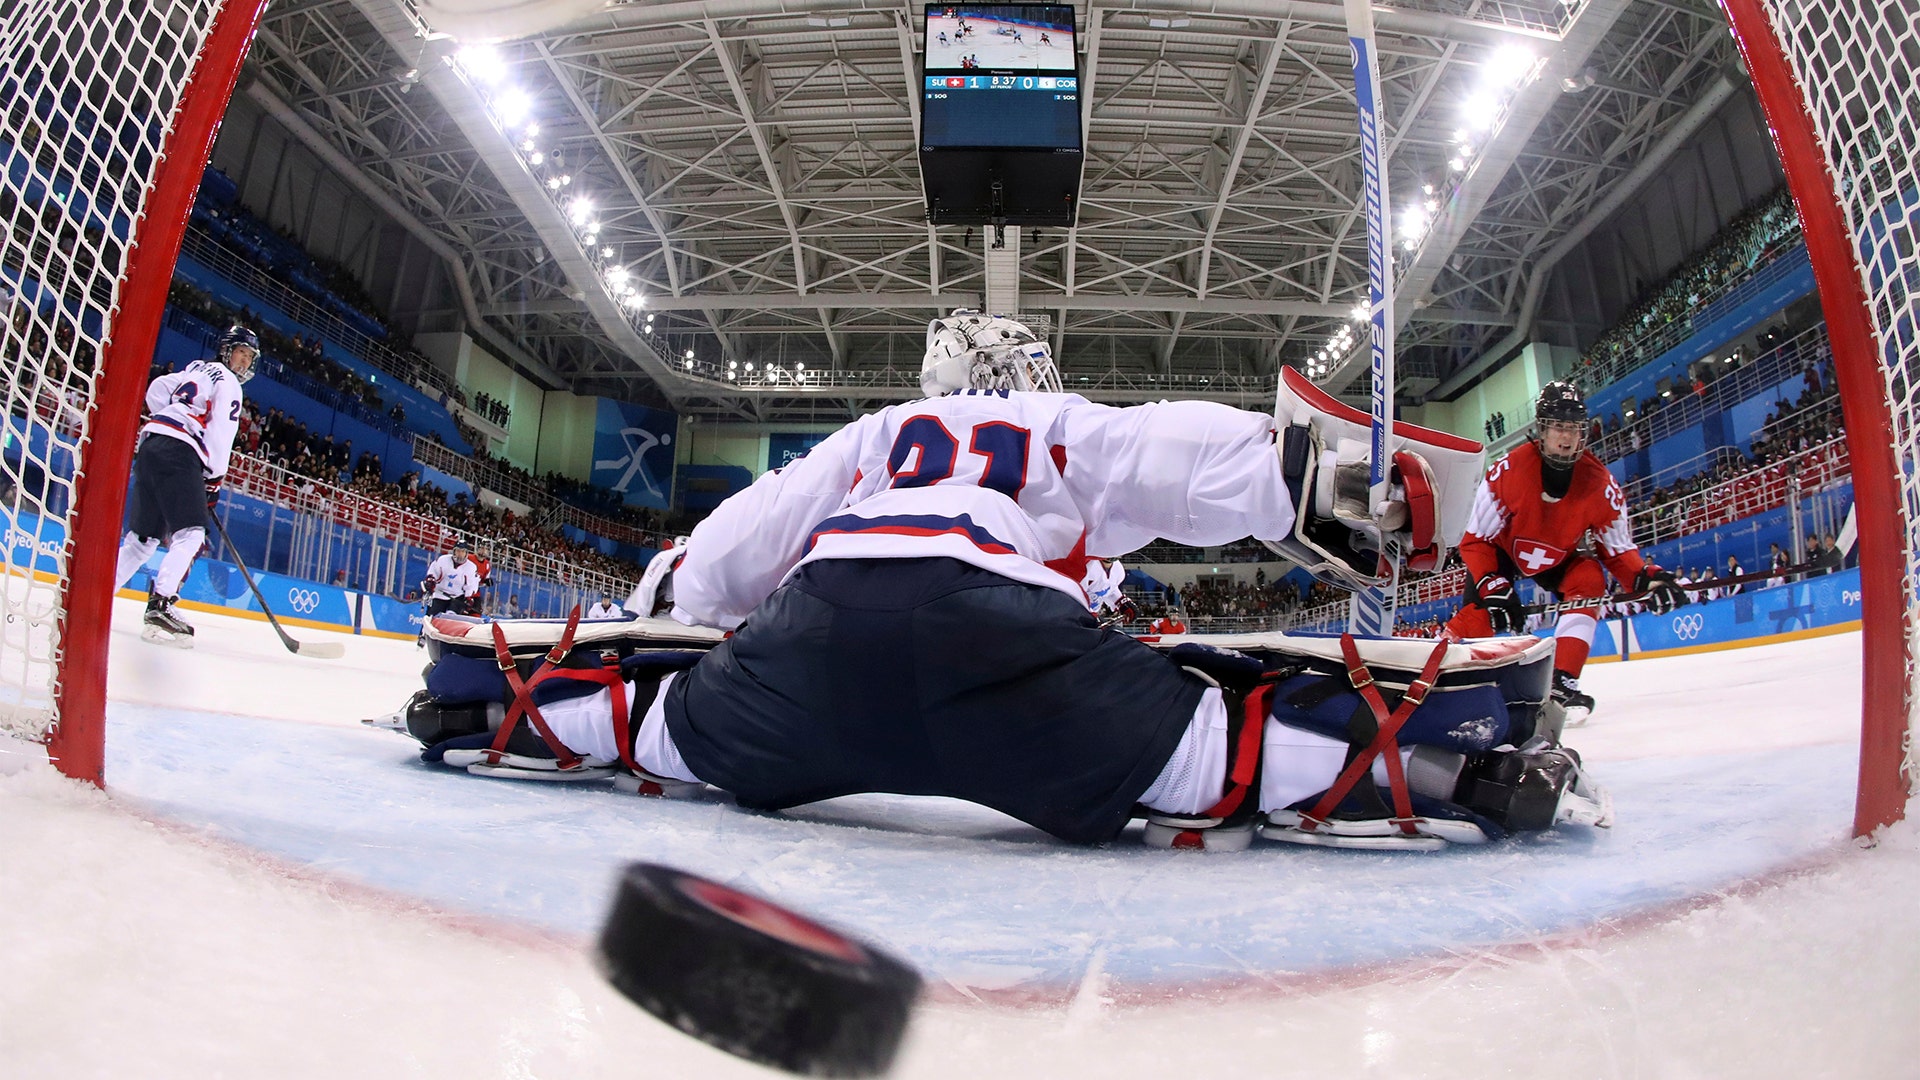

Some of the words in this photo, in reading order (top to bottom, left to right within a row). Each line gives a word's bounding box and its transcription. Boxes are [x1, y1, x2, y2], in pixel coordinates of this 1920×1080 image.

[969, 77, 980, 89] 1
[1023, 77, 1033, 90] 0
[1056, 79, 1077, 89] COR
[1360, 107, 1383, 293] WARRIOR
[1562, 391, 1573, 400] 25
[1376, 429, 1384, 478] SWAGGER
